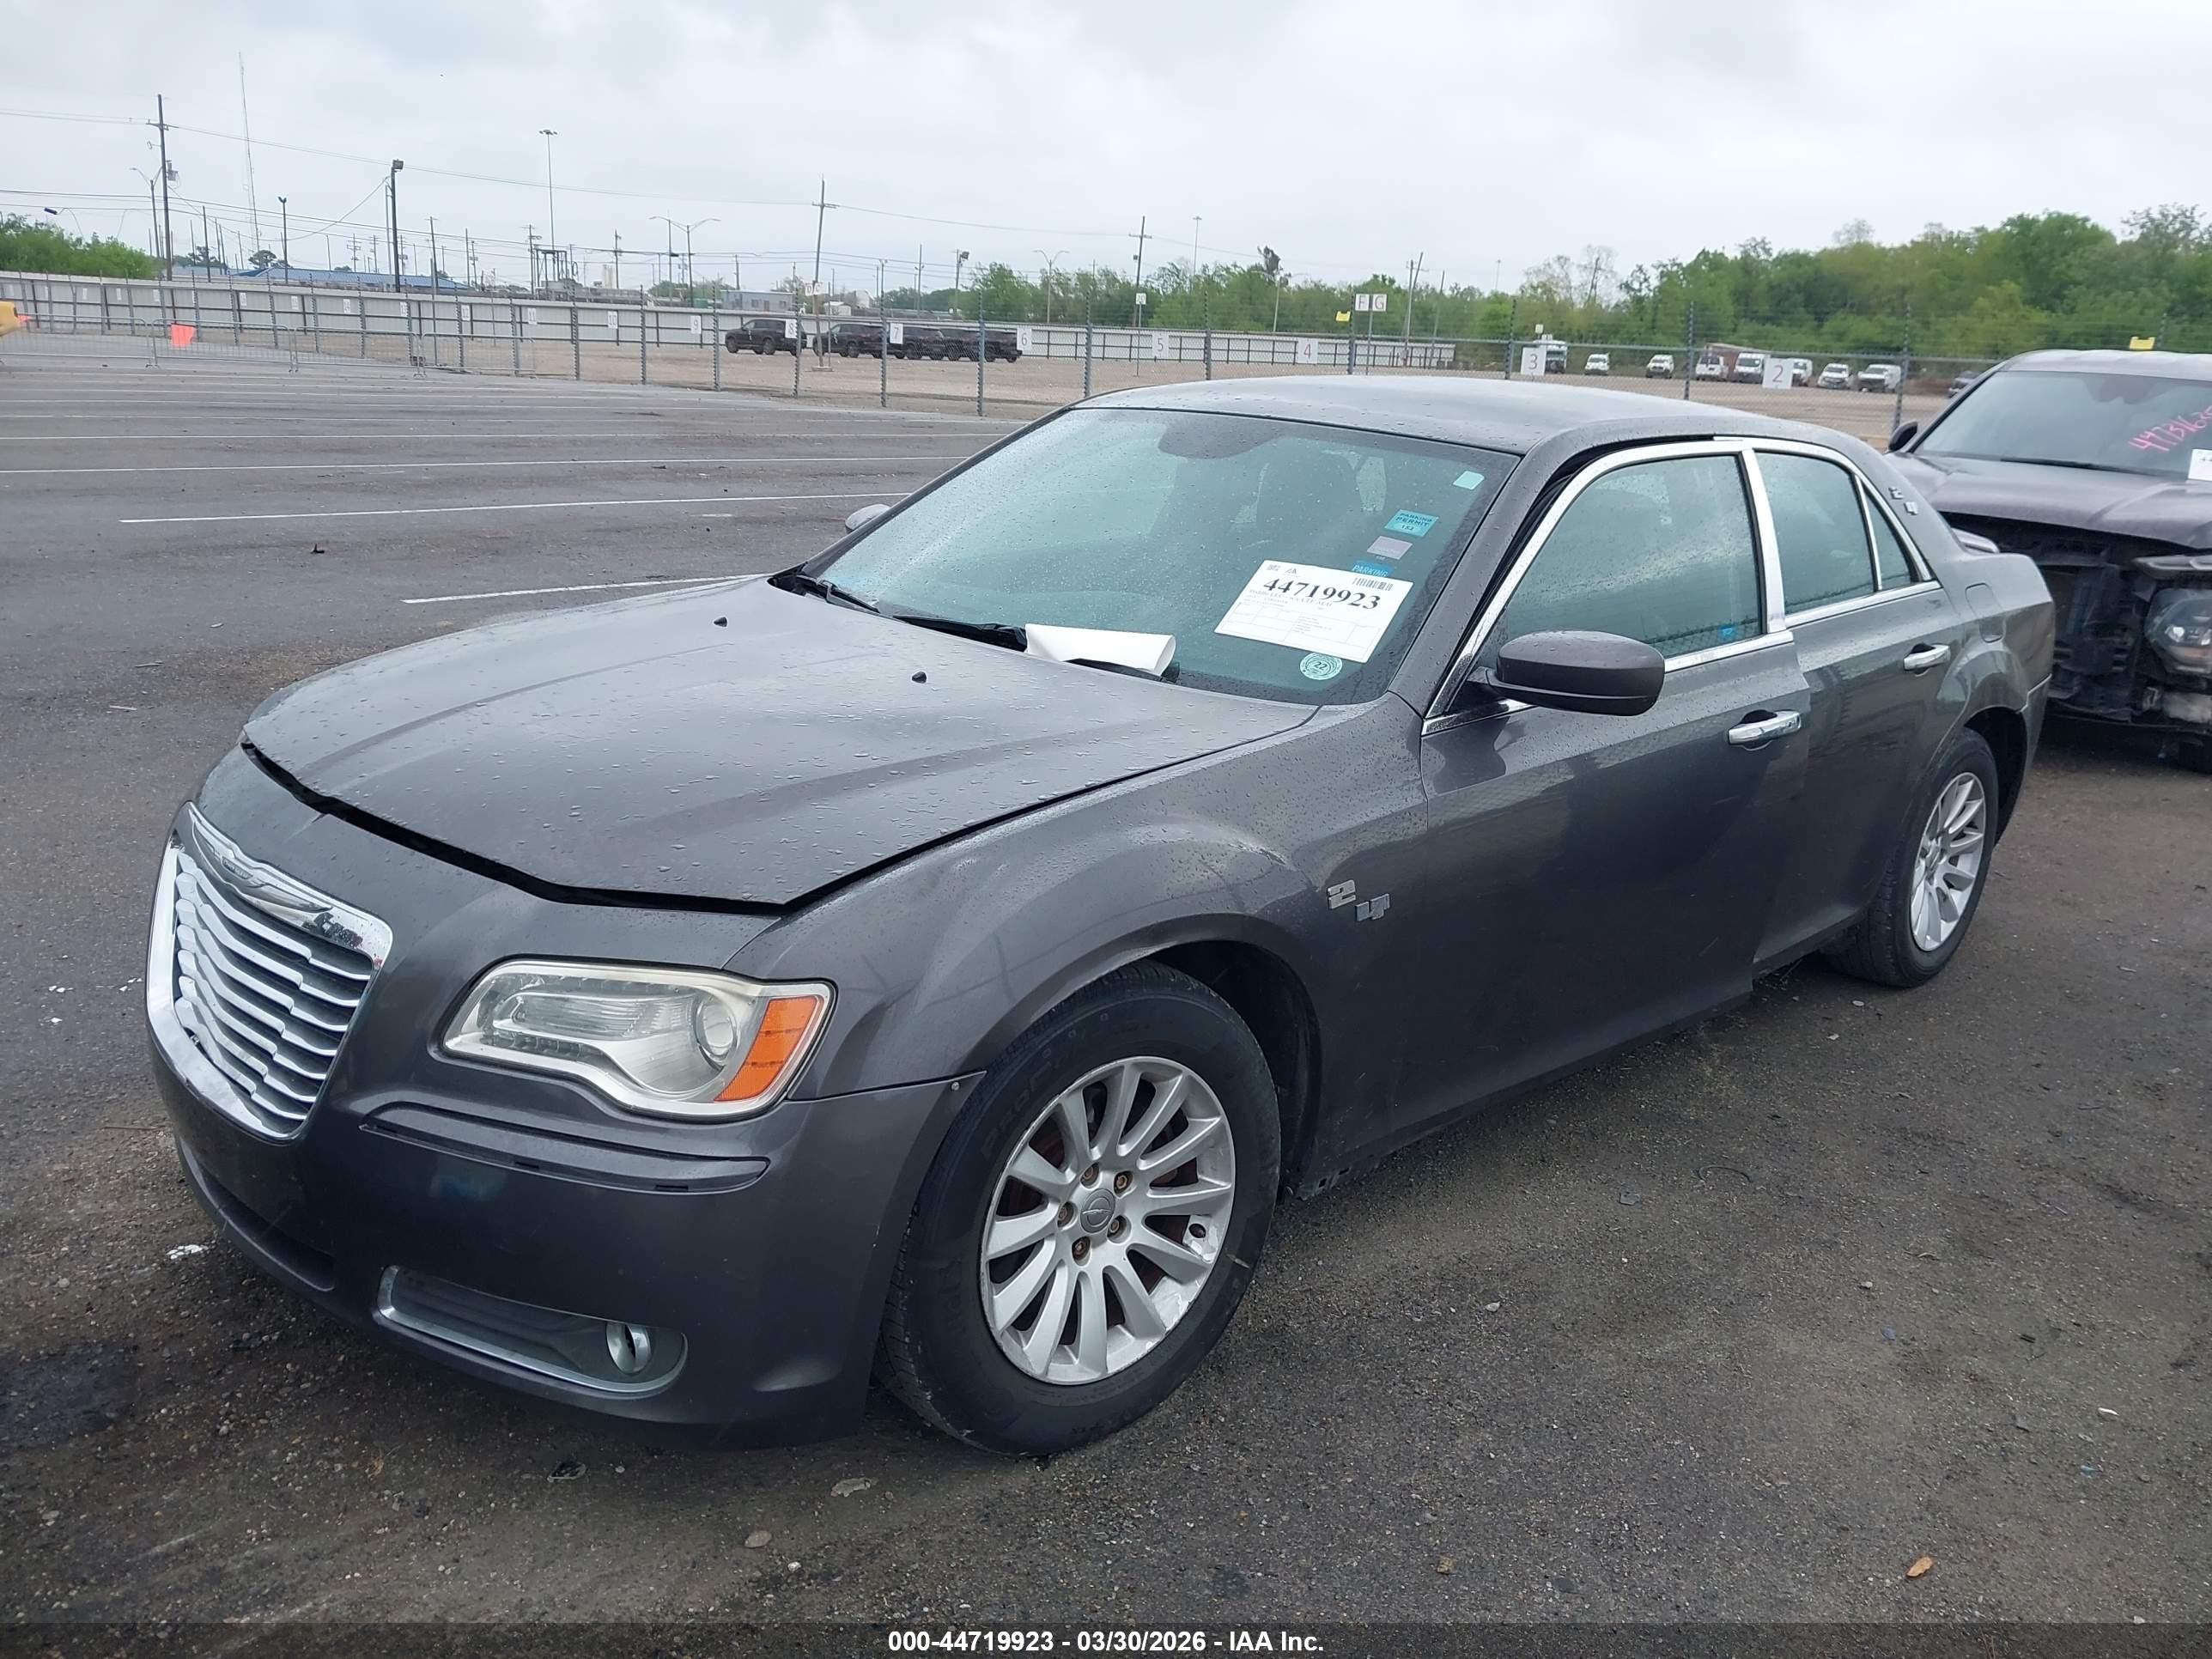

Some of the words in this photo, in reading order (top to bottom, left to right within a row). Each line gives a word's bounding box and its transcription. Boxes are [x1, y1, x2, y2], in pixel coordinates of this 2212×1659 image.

[1358, 296, 1365, 309] F
[1374, 295, 1384, 309] G
[609, 313, 617, 325] 10
[893, 327, 900, 341] 7
[1021, 331, 1028, 346] 6
[1157, 337, 1164, 352] 5
[1304, 343, 1311, 358] 4
[1528, 353, 1538, 370] 3
[1772, 364, 1783, 383] 2
[1395, 516, 1430, 527] PERMIT
[1352, 564, 1389, 577] PARKING
[1263, 578, 1381, 610] 44719923
